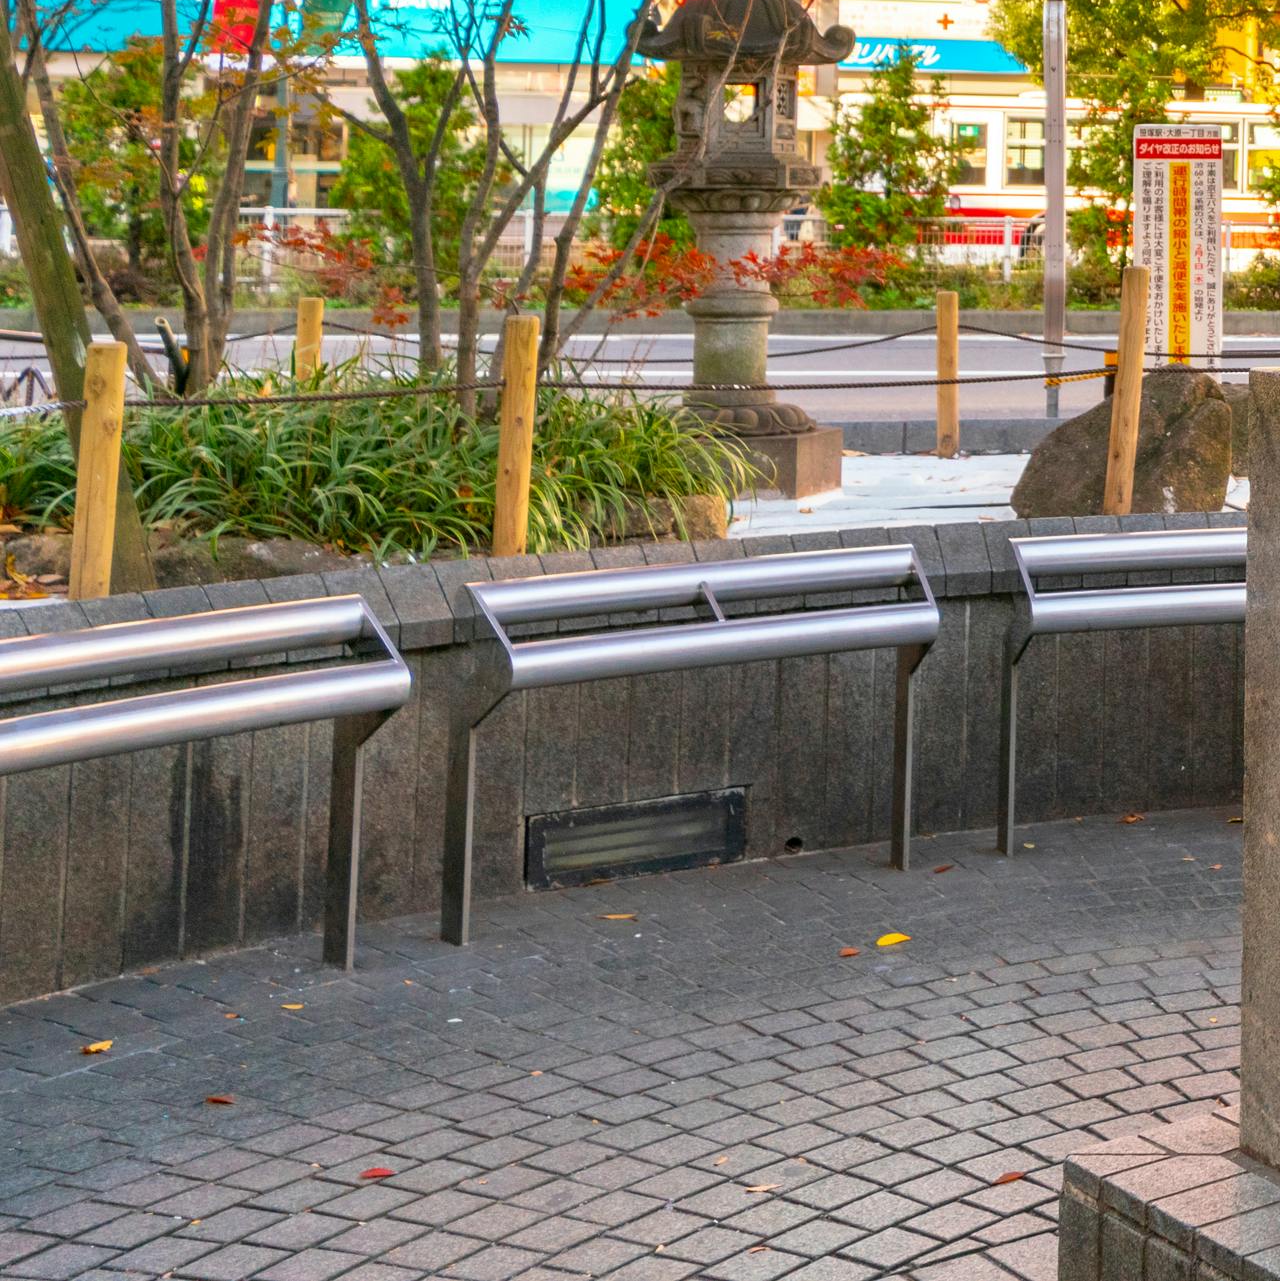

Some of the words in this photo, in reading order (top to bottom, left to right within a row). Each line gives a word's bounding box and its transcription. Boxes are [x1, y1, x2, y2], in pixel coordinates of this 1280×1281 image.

[1138, 142, 1220, 155] ダイヤ改正のお知らせ
